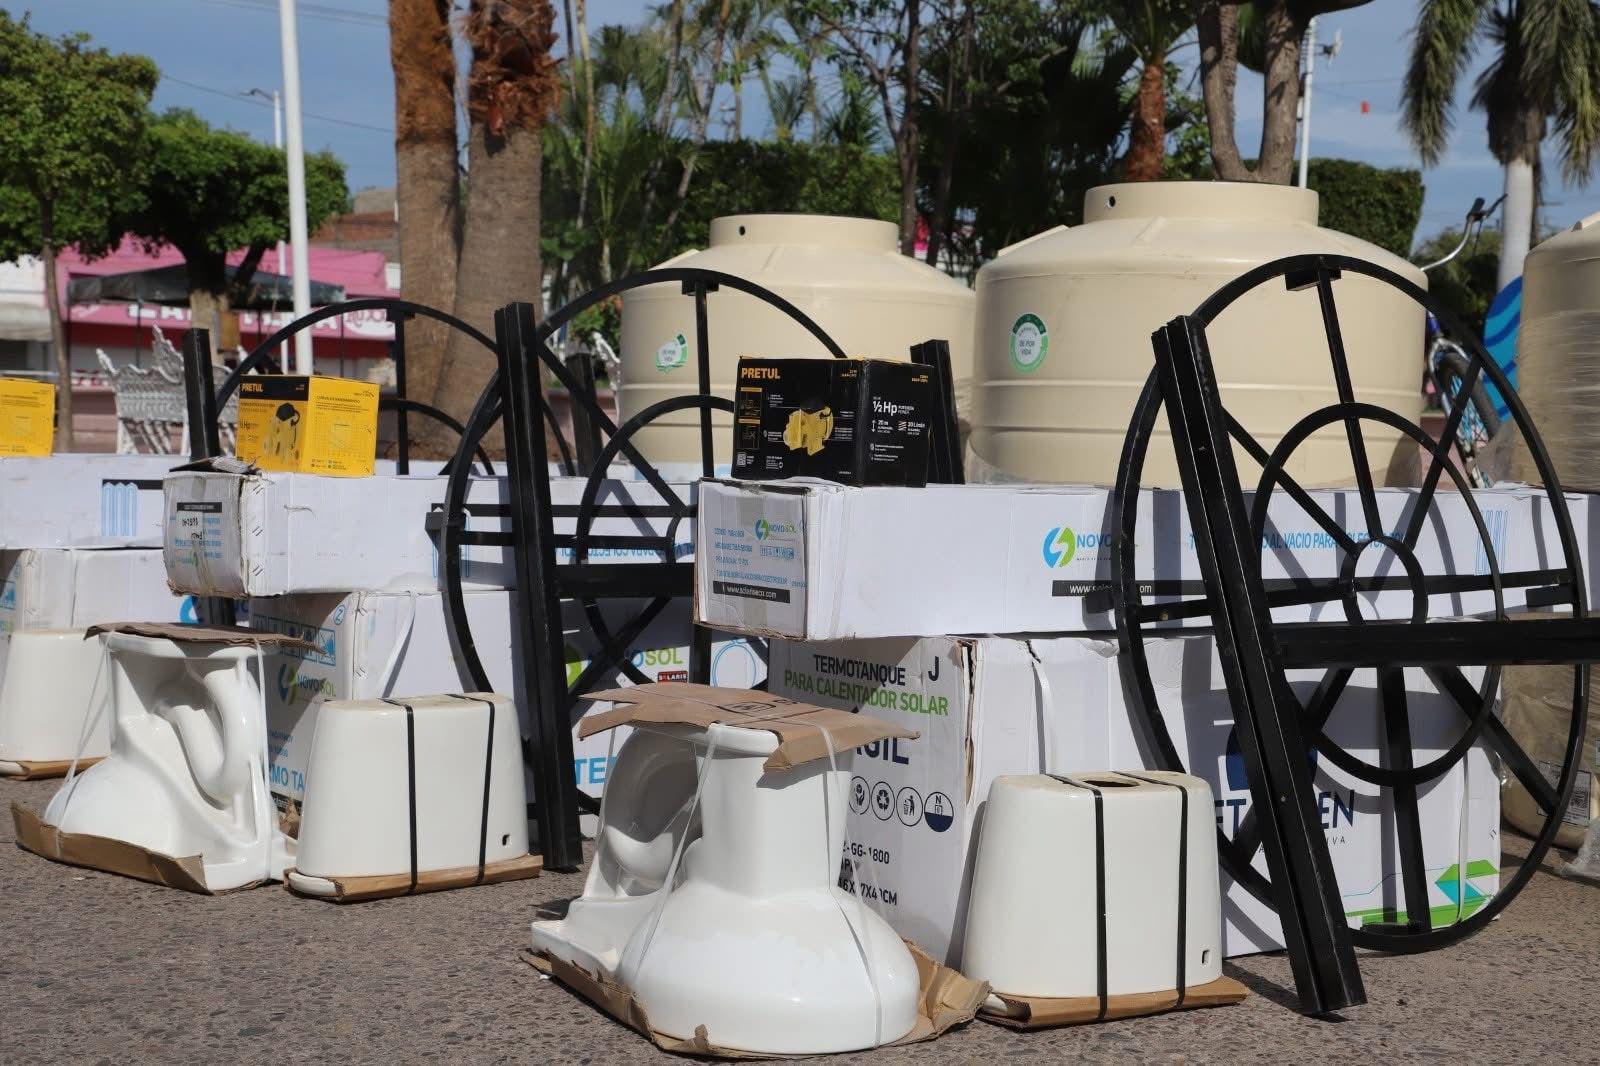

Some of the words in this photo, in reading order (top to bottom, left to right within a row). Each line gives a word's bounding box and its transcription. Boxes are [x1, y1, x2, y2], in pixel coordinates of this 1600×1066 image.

[741, 367, 781, 380] PRETUL
[241, 383, 264, 393] PRETUL
[813, 654, 906, 687] TERMOTANQUE
[784, 669, 813, 693] PARA
[816, 677, 898, 709] CALENTADOR
[900, 691, 948, 716] SOLAR
